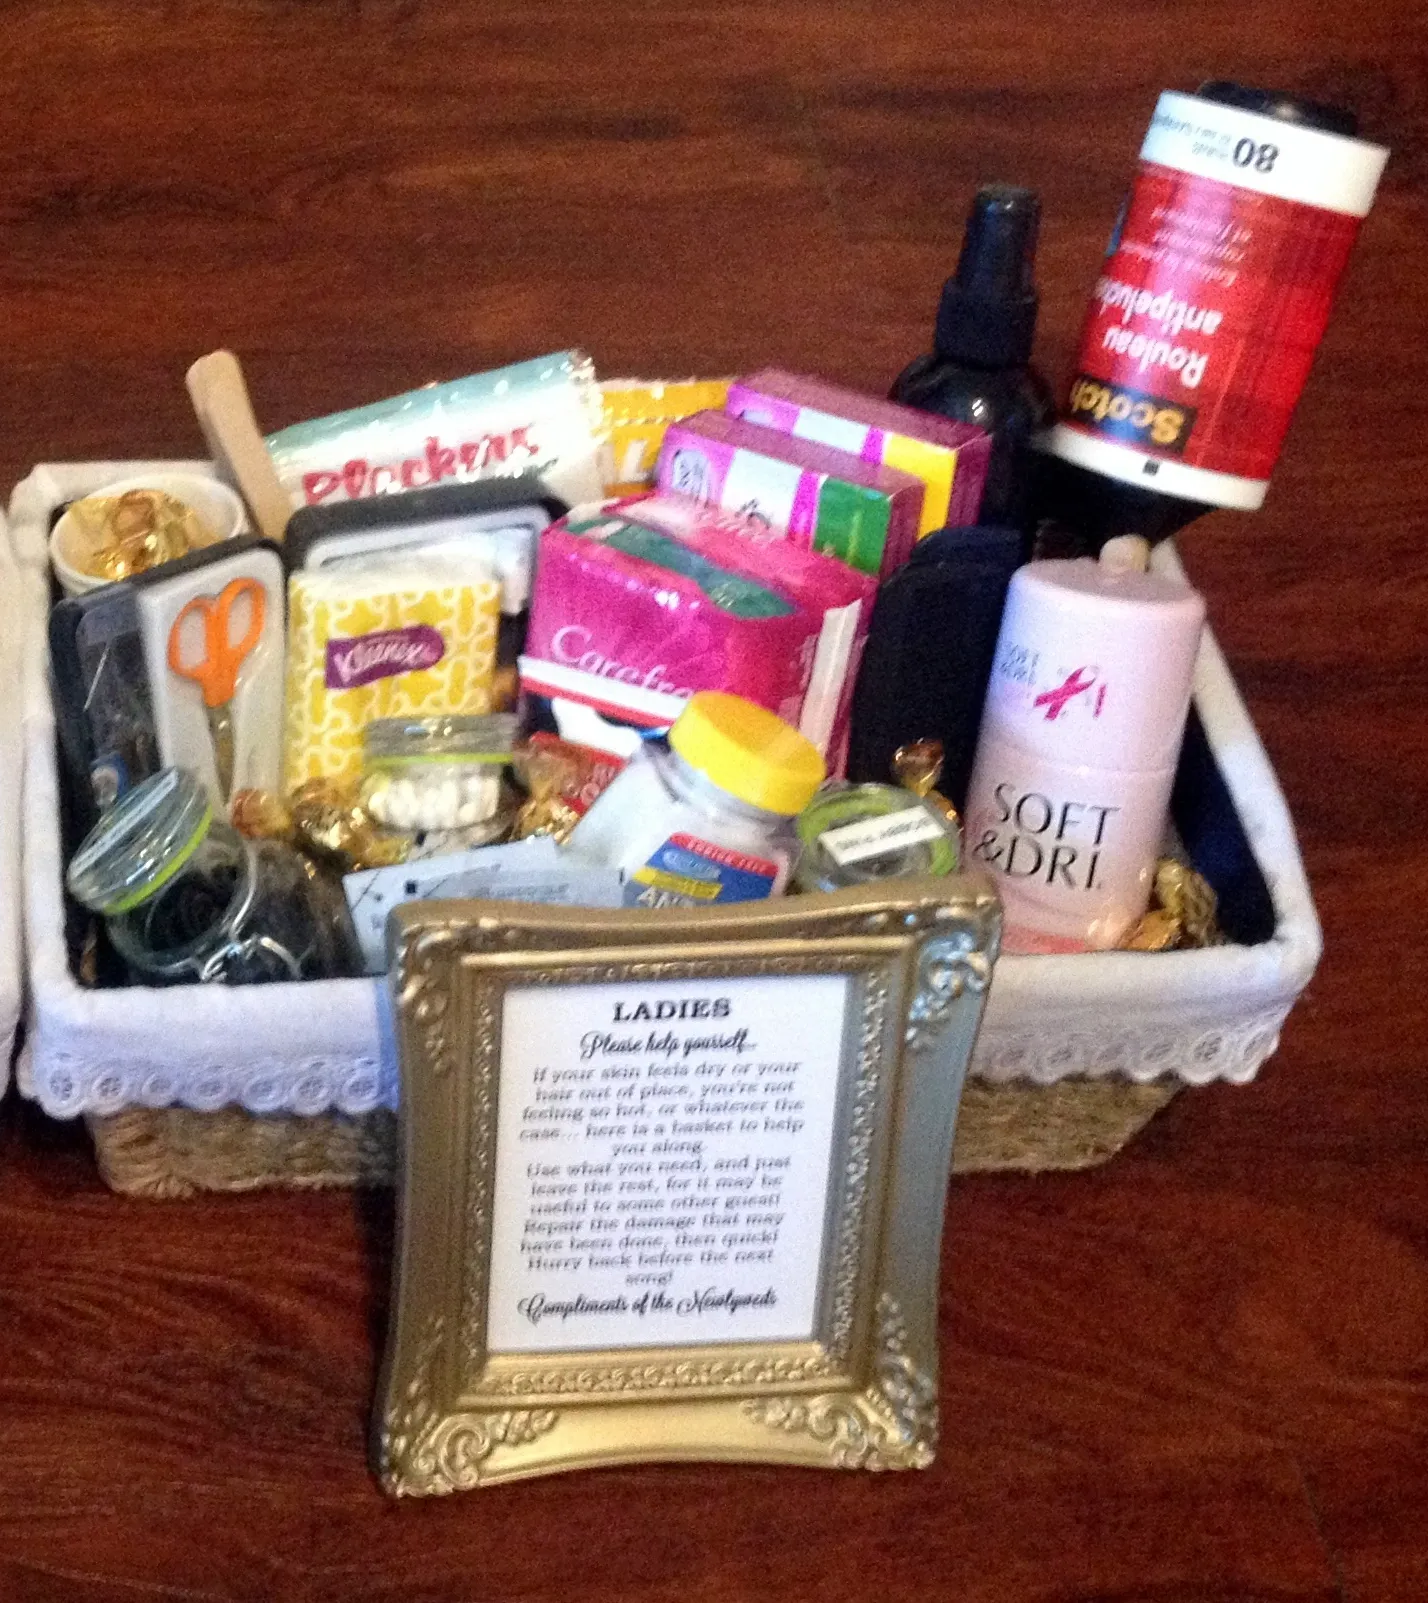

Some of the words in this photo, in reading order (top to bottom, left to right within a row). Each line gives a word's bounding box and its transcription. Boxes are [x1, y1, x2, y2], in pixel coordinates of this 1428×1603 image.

[1233, 136, 1280, 174] 80
[1102, 325, 1209, 389] Rouleau
[1070, 378, 1185, 445] Scotch
[993, 782, 1120, 845] SOFT
[613, 998, 729, 1022] LADIES
[580, 1031, 641, 1060] Please
[645, 1031, 679, 1058] help
[517, 1293, 628, 1325] Compliments
[632, 1291, 649, 1316] of
[650, 1290, 672, 1311] the
[676, 1286, 777, 1316] Newlyweds
